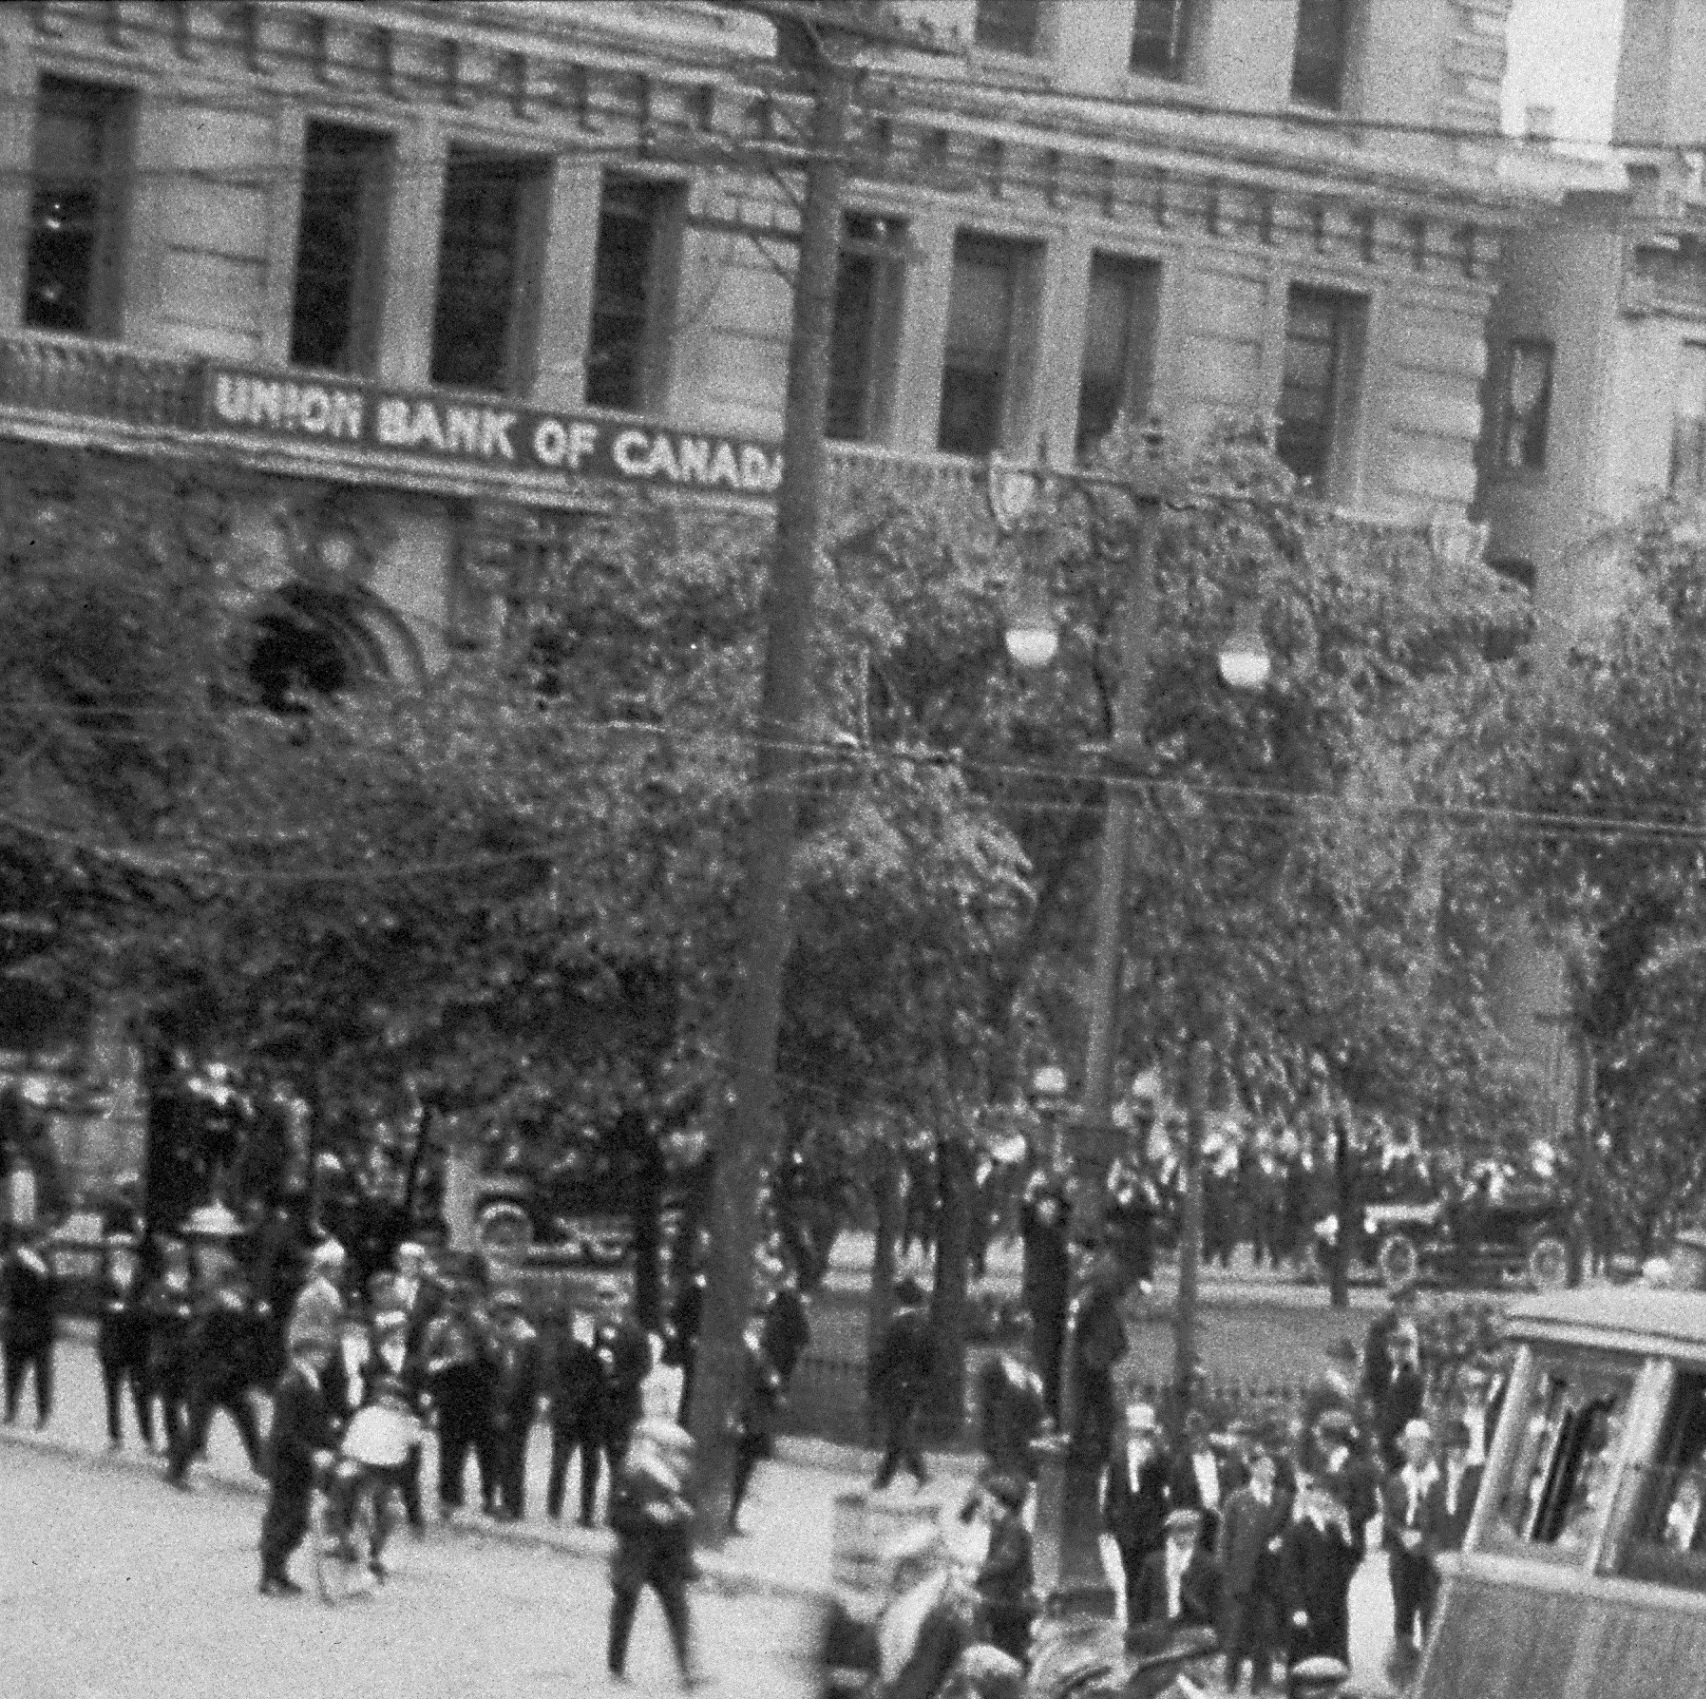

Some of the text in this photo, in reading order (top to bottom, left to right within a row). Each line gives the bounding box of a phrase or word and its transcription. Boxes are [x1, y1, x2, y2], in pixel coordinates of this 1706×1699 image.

[216, 374, 363, 438] UNION
[378, 399, 517, 459] BANK
[534, 420, 597, 468] OF
